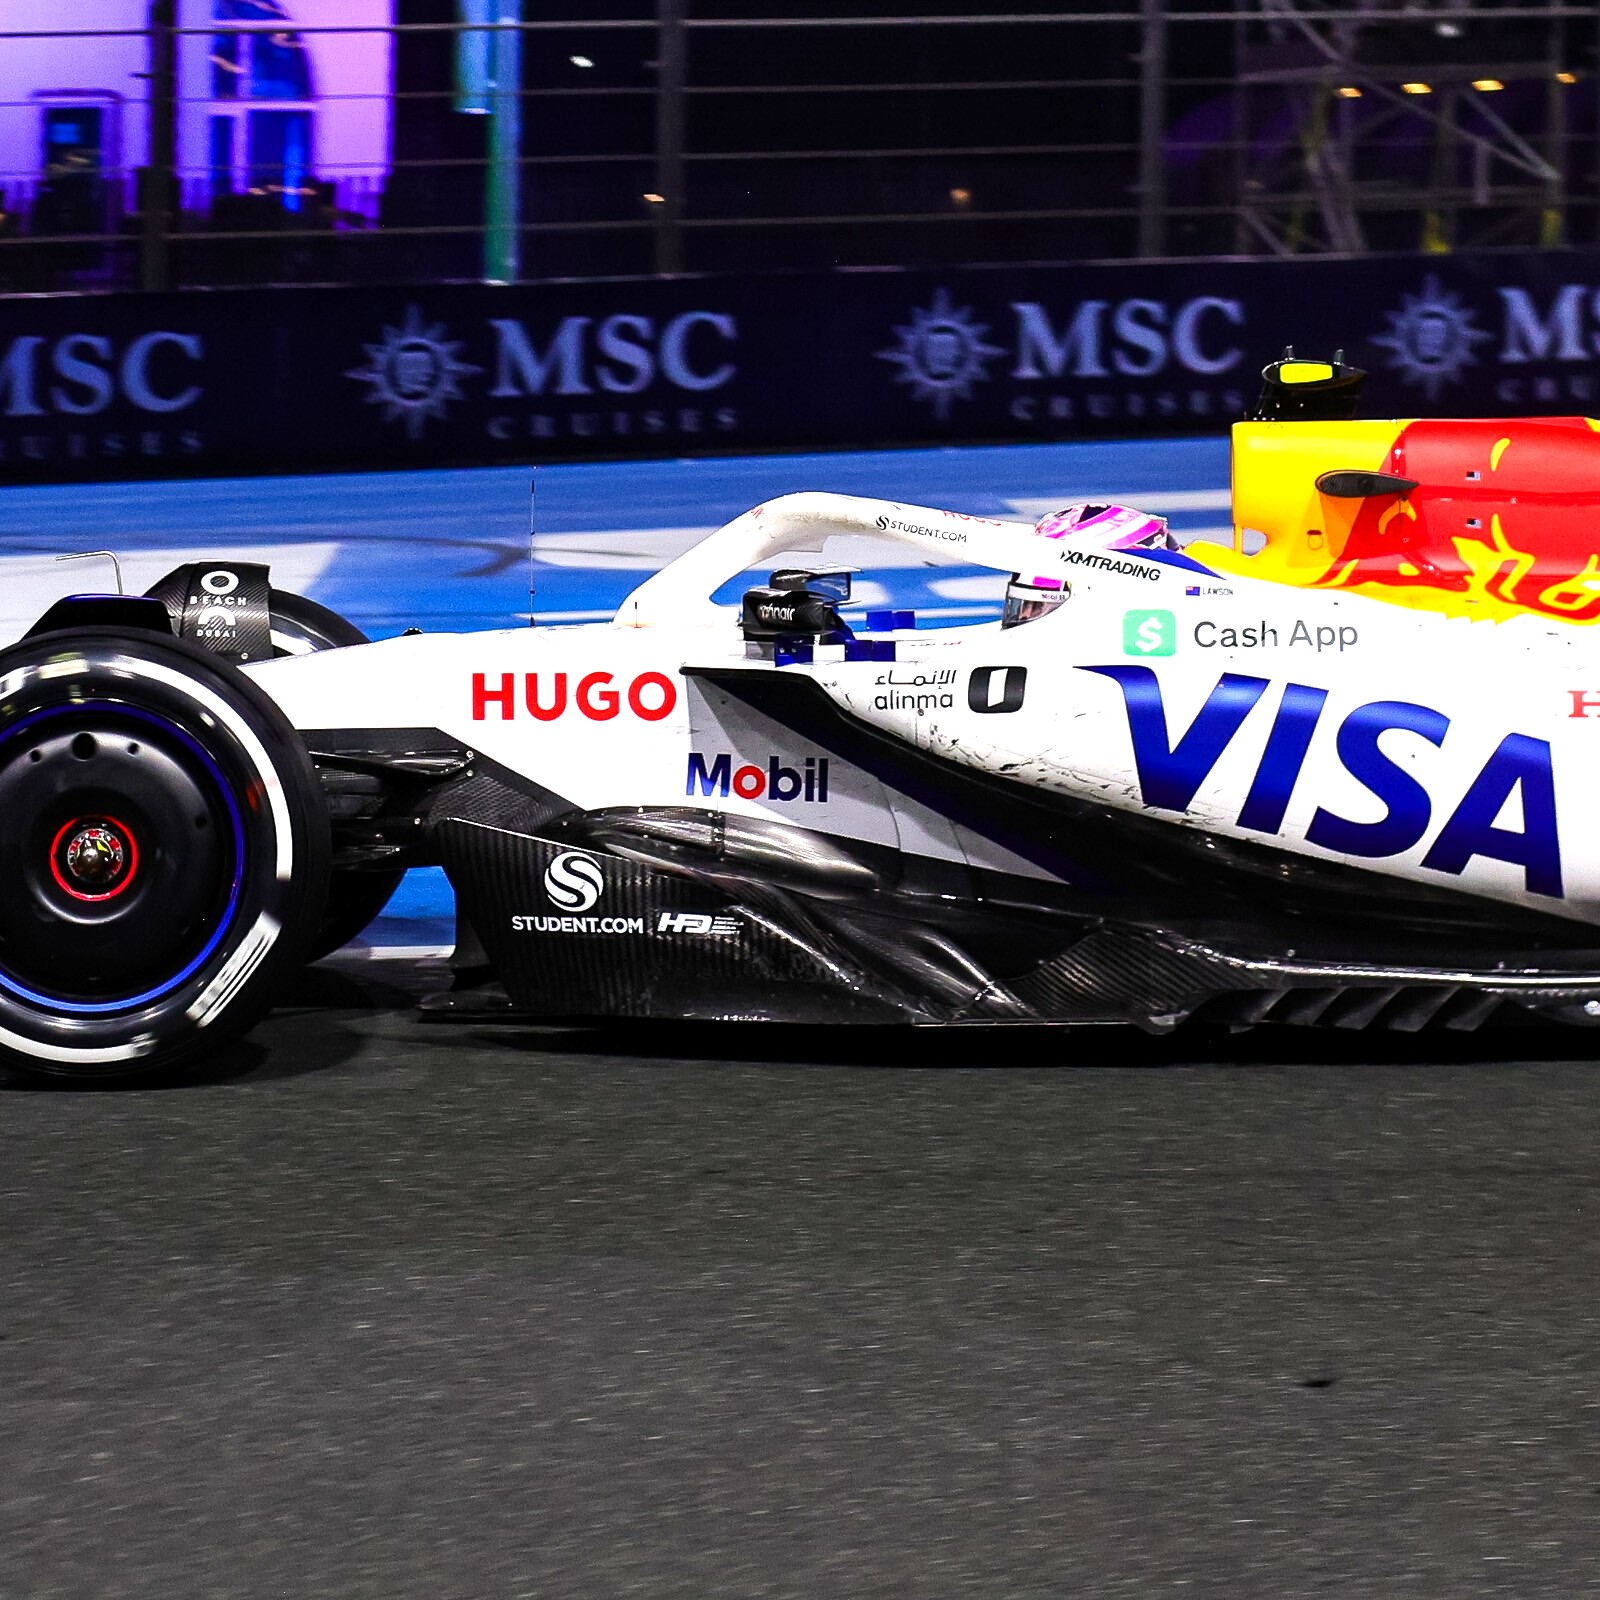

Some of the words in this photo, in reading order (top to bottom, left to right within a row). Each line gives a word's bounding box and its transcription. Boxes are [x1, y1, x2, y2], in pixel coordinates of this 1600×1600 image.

[1011, 297, 1245, 380] MSC
[489, 311, 738, 397] MSC
[890, 520, 967, 543] STUDENT.COM
[189, 595, 247, 606] BEACH
[1202, 587, 1234, 596] LAWSON
[196, 629, 237, 638] DUBAI
[1194, 619, 1278, 648] Cash
[1289, 619, 1358, 652] App
[472, 671, 677, 721] HUGO
[875, 689, 953, 711] alinma
[686, 752, 829, 803] Mobil
[1072, 664, 1566, 900] VISA
[512, 915, 644, 934] STUDENT.COM
